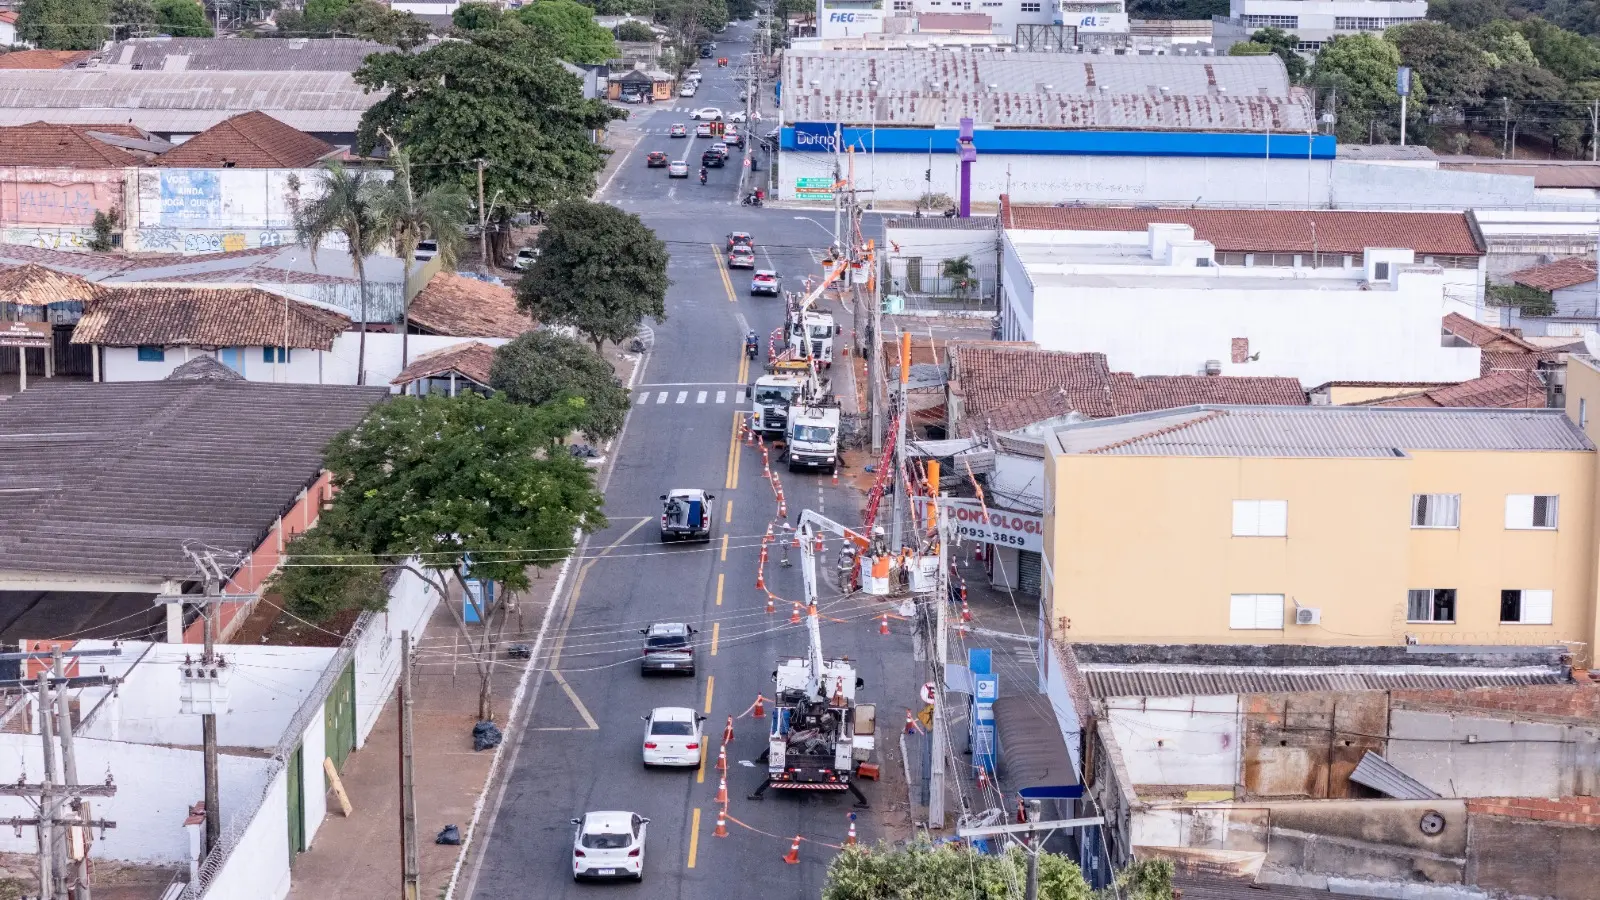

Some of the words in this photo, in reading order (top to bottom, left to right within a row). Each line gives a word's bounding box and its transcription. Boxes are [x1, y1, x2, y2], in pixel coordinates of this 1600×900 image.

[797, 133, 835, 145] Dufrio
[177, 187, 204, 196] AINDA
[947, 505, 1043, 535] DONTOLOGI
